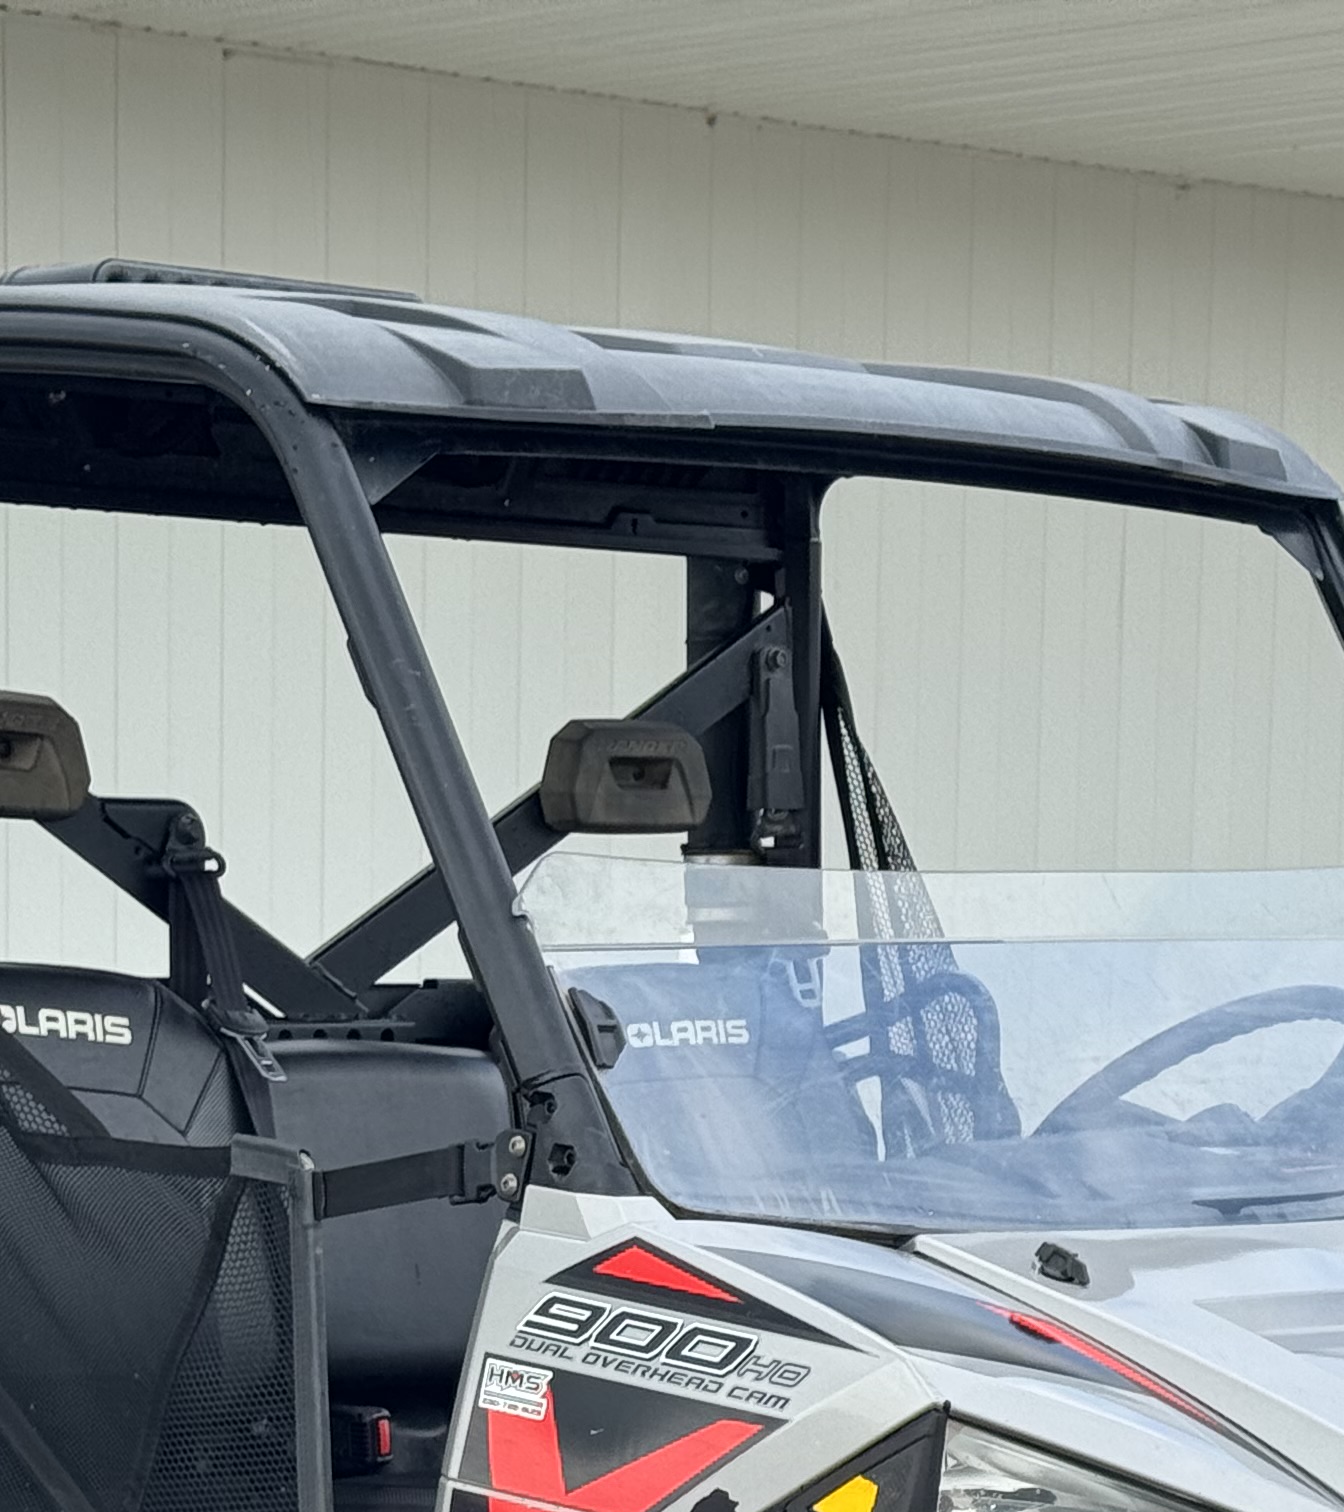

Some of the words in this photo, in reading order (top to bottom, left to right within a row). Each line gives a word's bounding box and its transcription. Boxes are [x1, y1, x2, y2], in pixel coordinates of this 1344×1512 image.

[626, 1019, 749, 1048] OLARIS
[488, 1365, 541, 1391] HMS
[509, 1334, 574, 1361] DUAL
[582, 1352, 724, 1394] OVERHEAD
[726, 1386, 791, 1410] CAM
